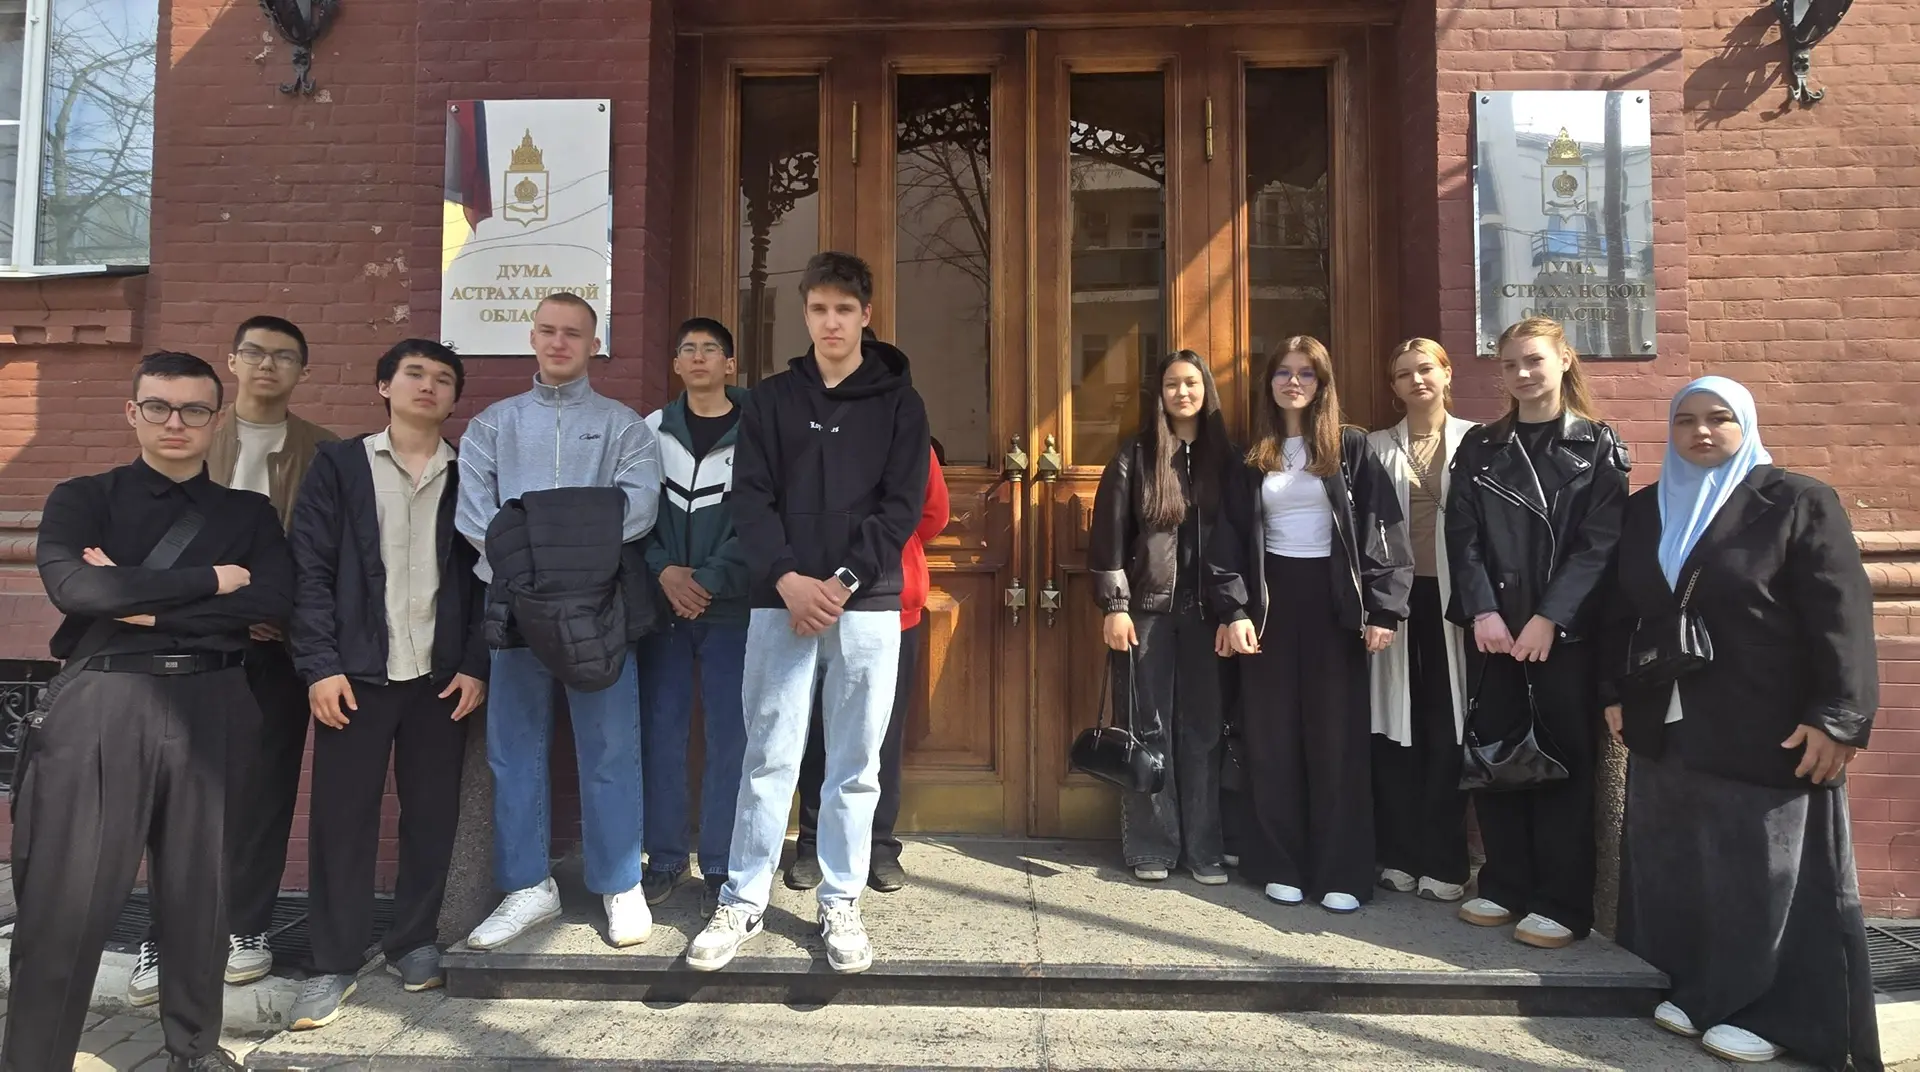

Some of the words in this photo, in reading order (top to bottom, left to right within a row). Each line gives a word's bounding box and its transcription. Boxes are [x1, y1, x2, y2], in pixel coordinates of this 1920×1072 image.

[496, 265, 552, 280] ДУМА
[1538, 261, 1597, 277] ДУМА
[480, 308, 537, 322] ОБЛА
